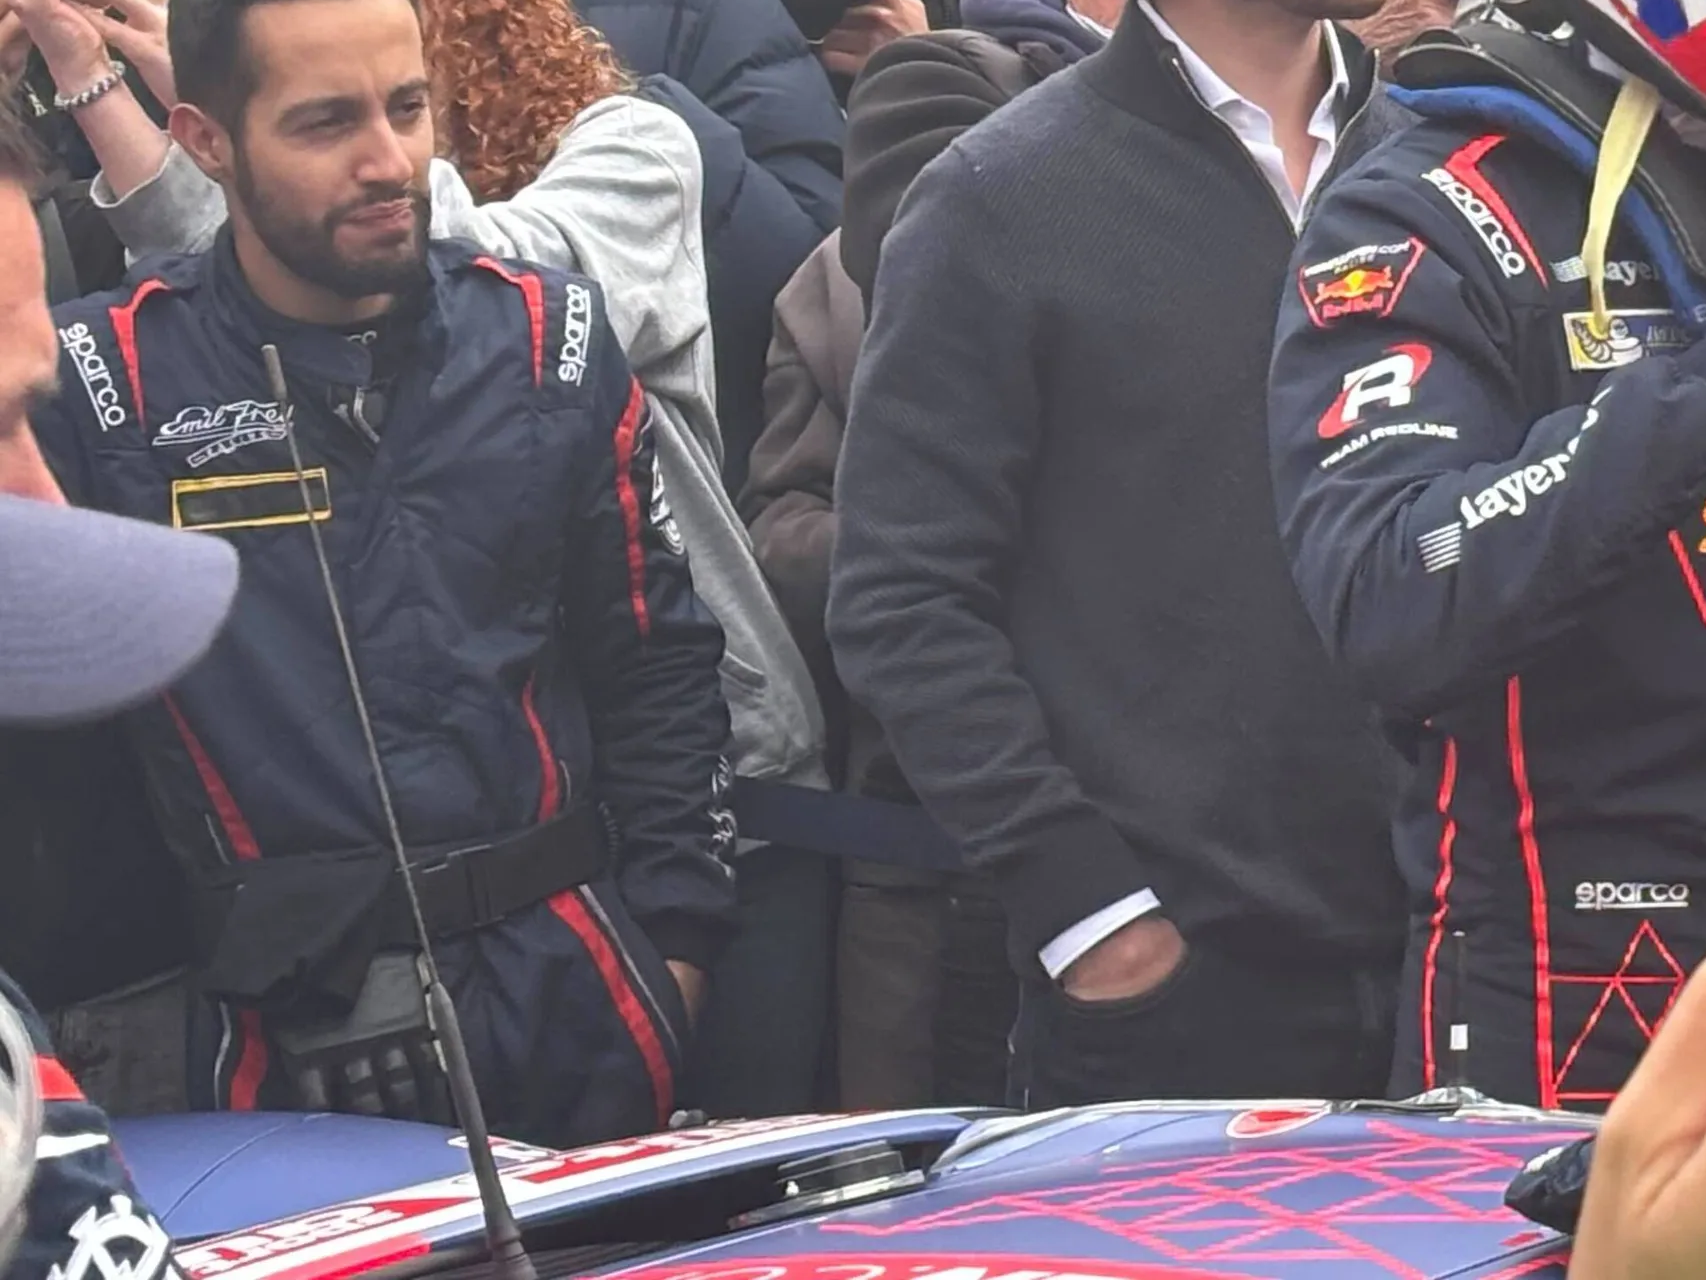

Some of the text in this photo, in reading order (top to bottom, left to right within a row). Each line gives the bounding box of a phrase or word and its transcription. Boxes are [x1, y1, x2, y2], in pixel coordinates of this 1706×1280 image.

[1421, 168, 1526, 279] sparco
[58, 321, 126, 432] sparco
[558, 283, 592, 387] sparco
[159, 405, 229, 437] Emil
[1574, 880, 1690, 912] sparco
